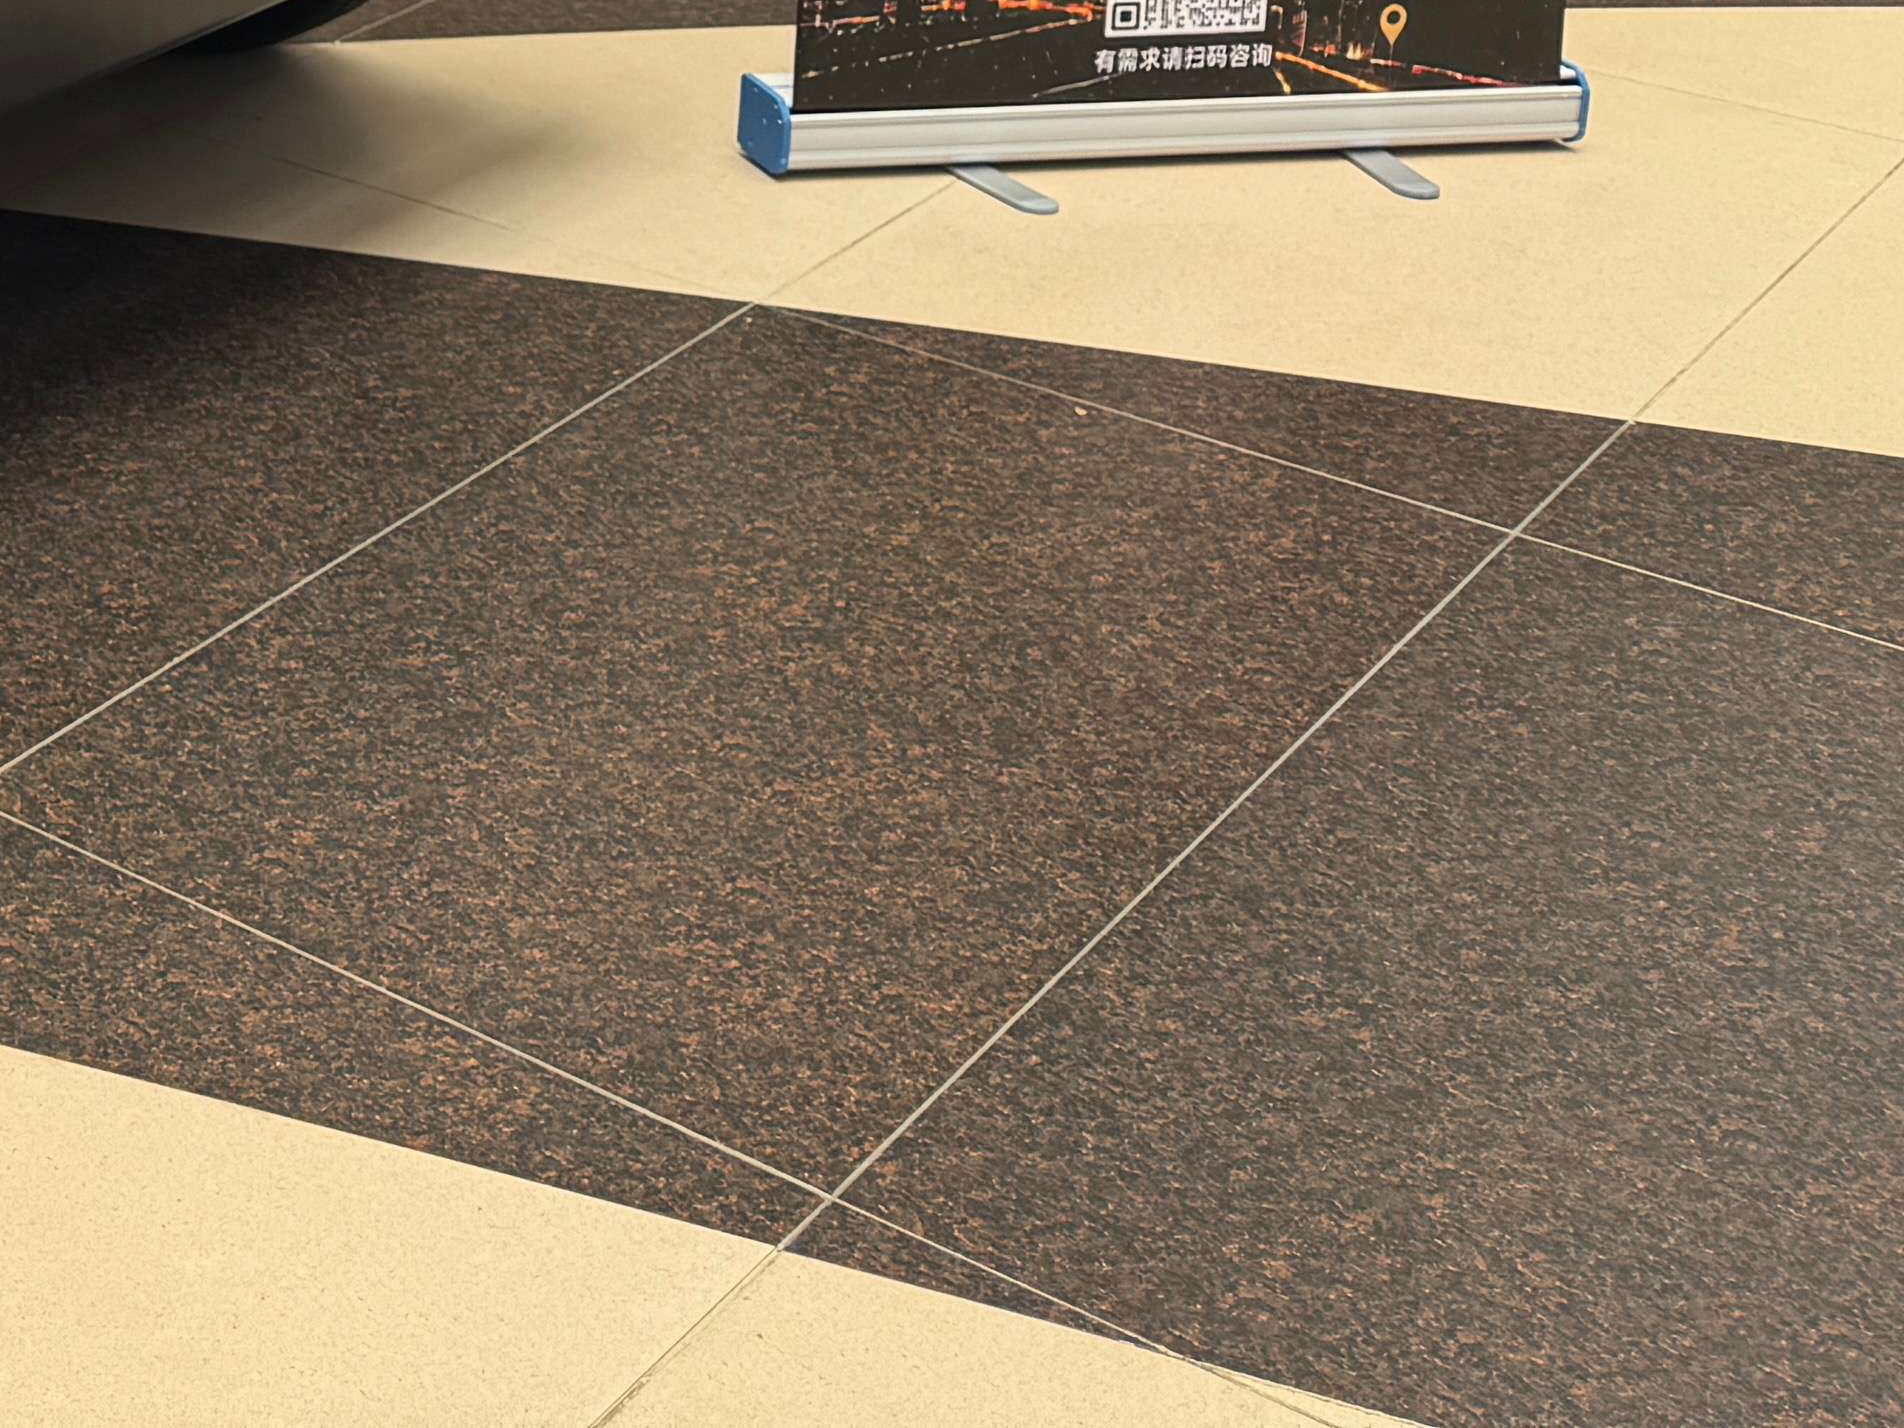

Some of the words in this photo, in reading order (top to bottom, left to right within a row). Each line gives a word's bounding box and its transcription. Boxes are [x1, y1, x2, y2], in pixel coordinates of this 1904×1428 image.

[1094, 43, 1274, 74] 有需求请扫码咨询
